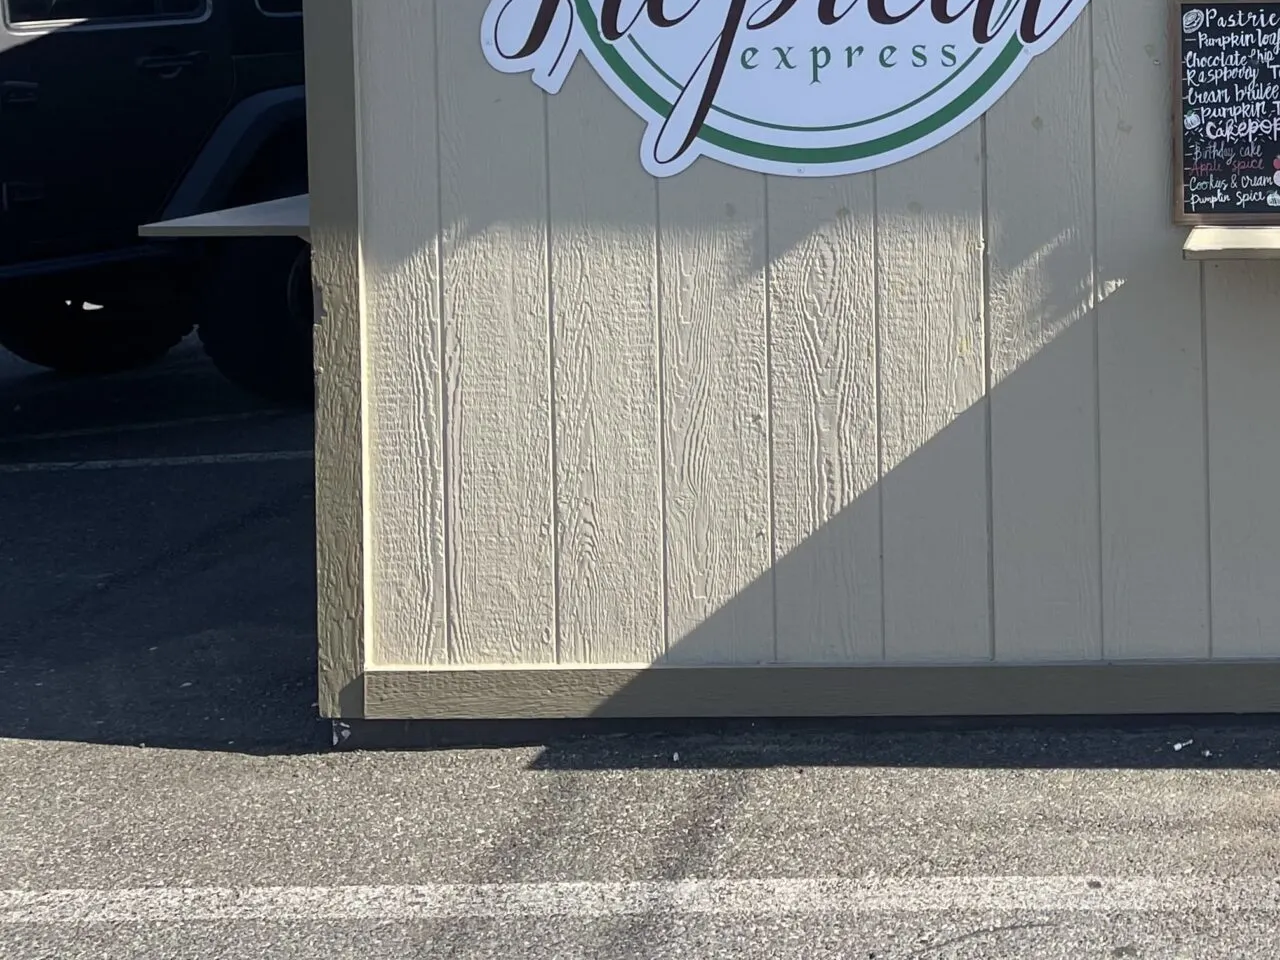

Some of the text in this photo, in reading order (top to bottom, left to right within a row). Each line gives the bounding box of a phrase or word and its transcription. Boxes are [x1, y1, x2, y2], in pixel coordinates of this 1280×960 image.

[1198, 31, 1256, 50] Pumpkin
[740, 43, 958, 83] express
[1184, 51, 1247, 68] Chocolate
[1193, 141, 1262, 165] Birthday cake
[1190, 159, 1264, 176] Apple spice
[1231, 174, 1237, 189] &
[1236, 190, 1265, 208] Spice
